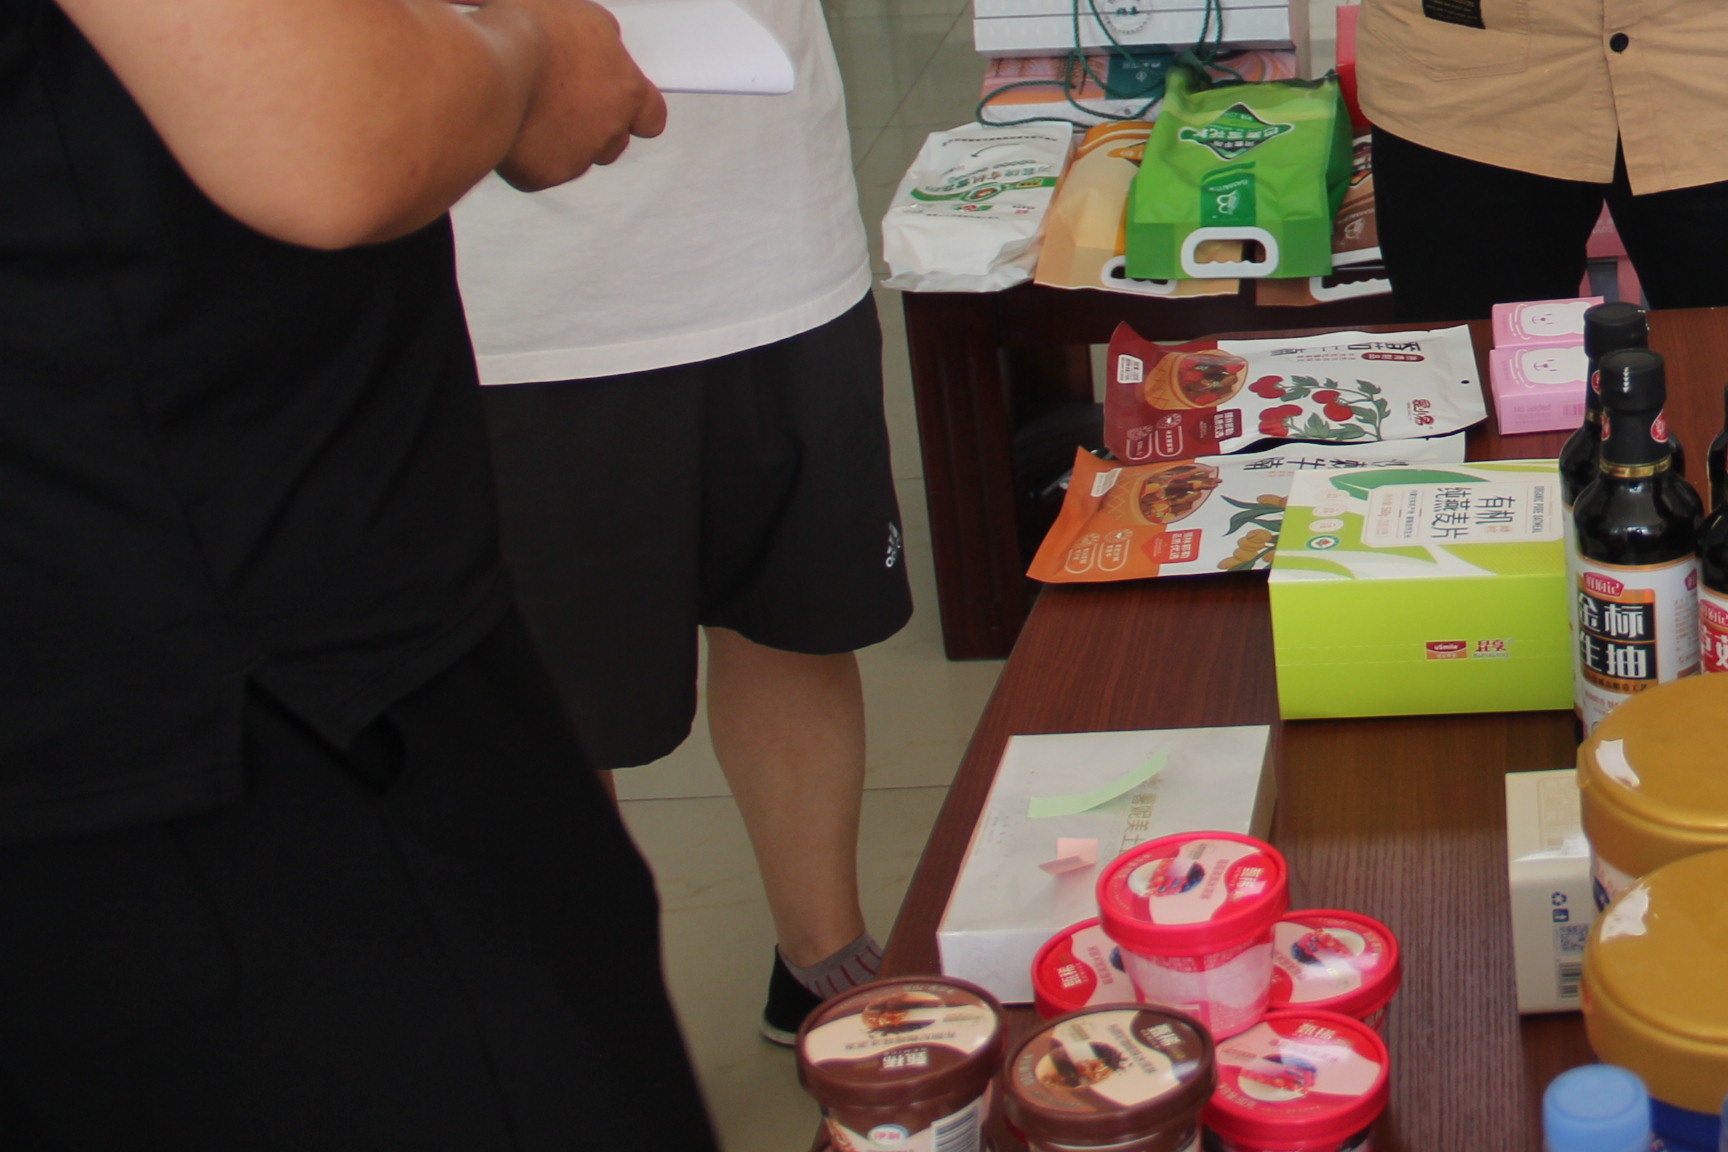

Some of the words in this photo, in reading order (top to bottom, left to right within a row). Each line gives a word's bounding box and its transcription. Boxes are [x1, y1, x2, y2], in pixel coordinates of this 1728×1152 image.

[1431, 487, 1472, 539] 纯燕麦片
[1475, 495, 1516, 525] 有机
[1578, 592, 1645, 639] 金标
[1579, 632, 1647, 679] 生抽
